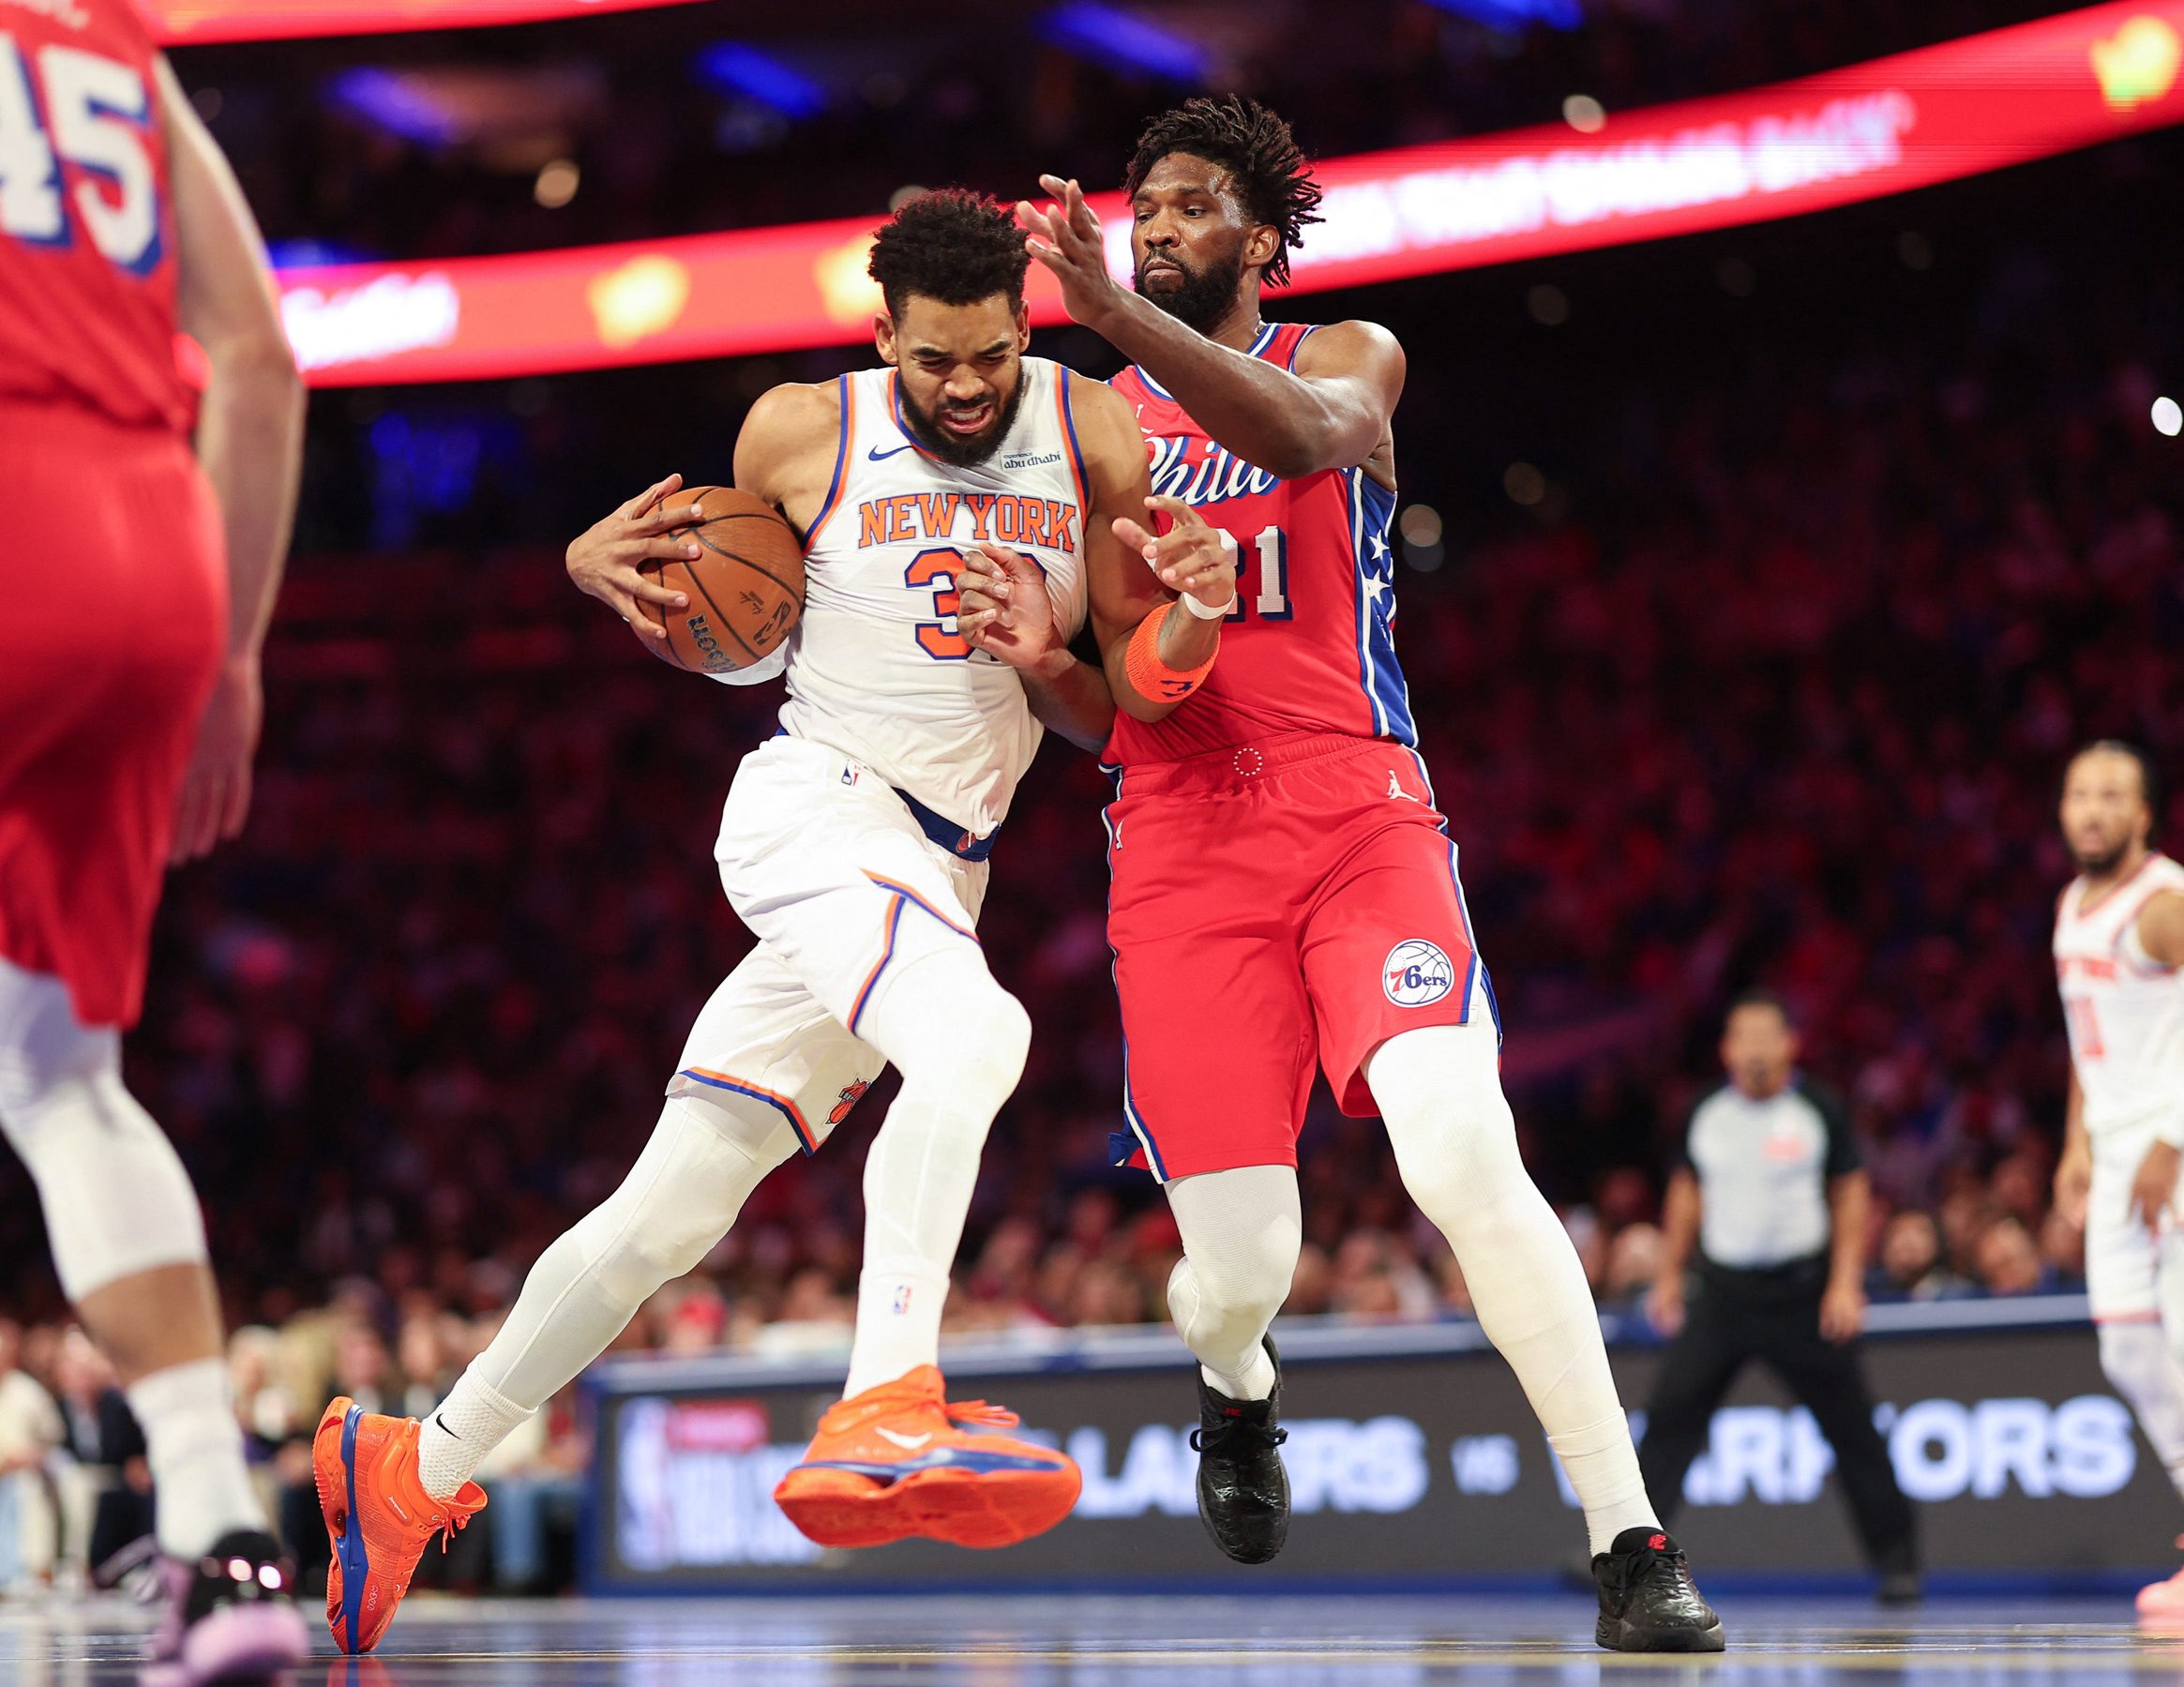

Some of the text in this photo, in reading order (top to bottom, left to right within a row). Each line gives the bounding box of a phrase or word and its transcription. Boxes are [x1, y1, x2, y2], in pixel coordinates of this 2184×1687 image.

[1003, 451, 1062, 469] abu dhabi
[858, 492, 1077, 554] NEW YORK
[904, 547, 1047, 661] 3
[1390, 964, 1448, 993] 76ers
